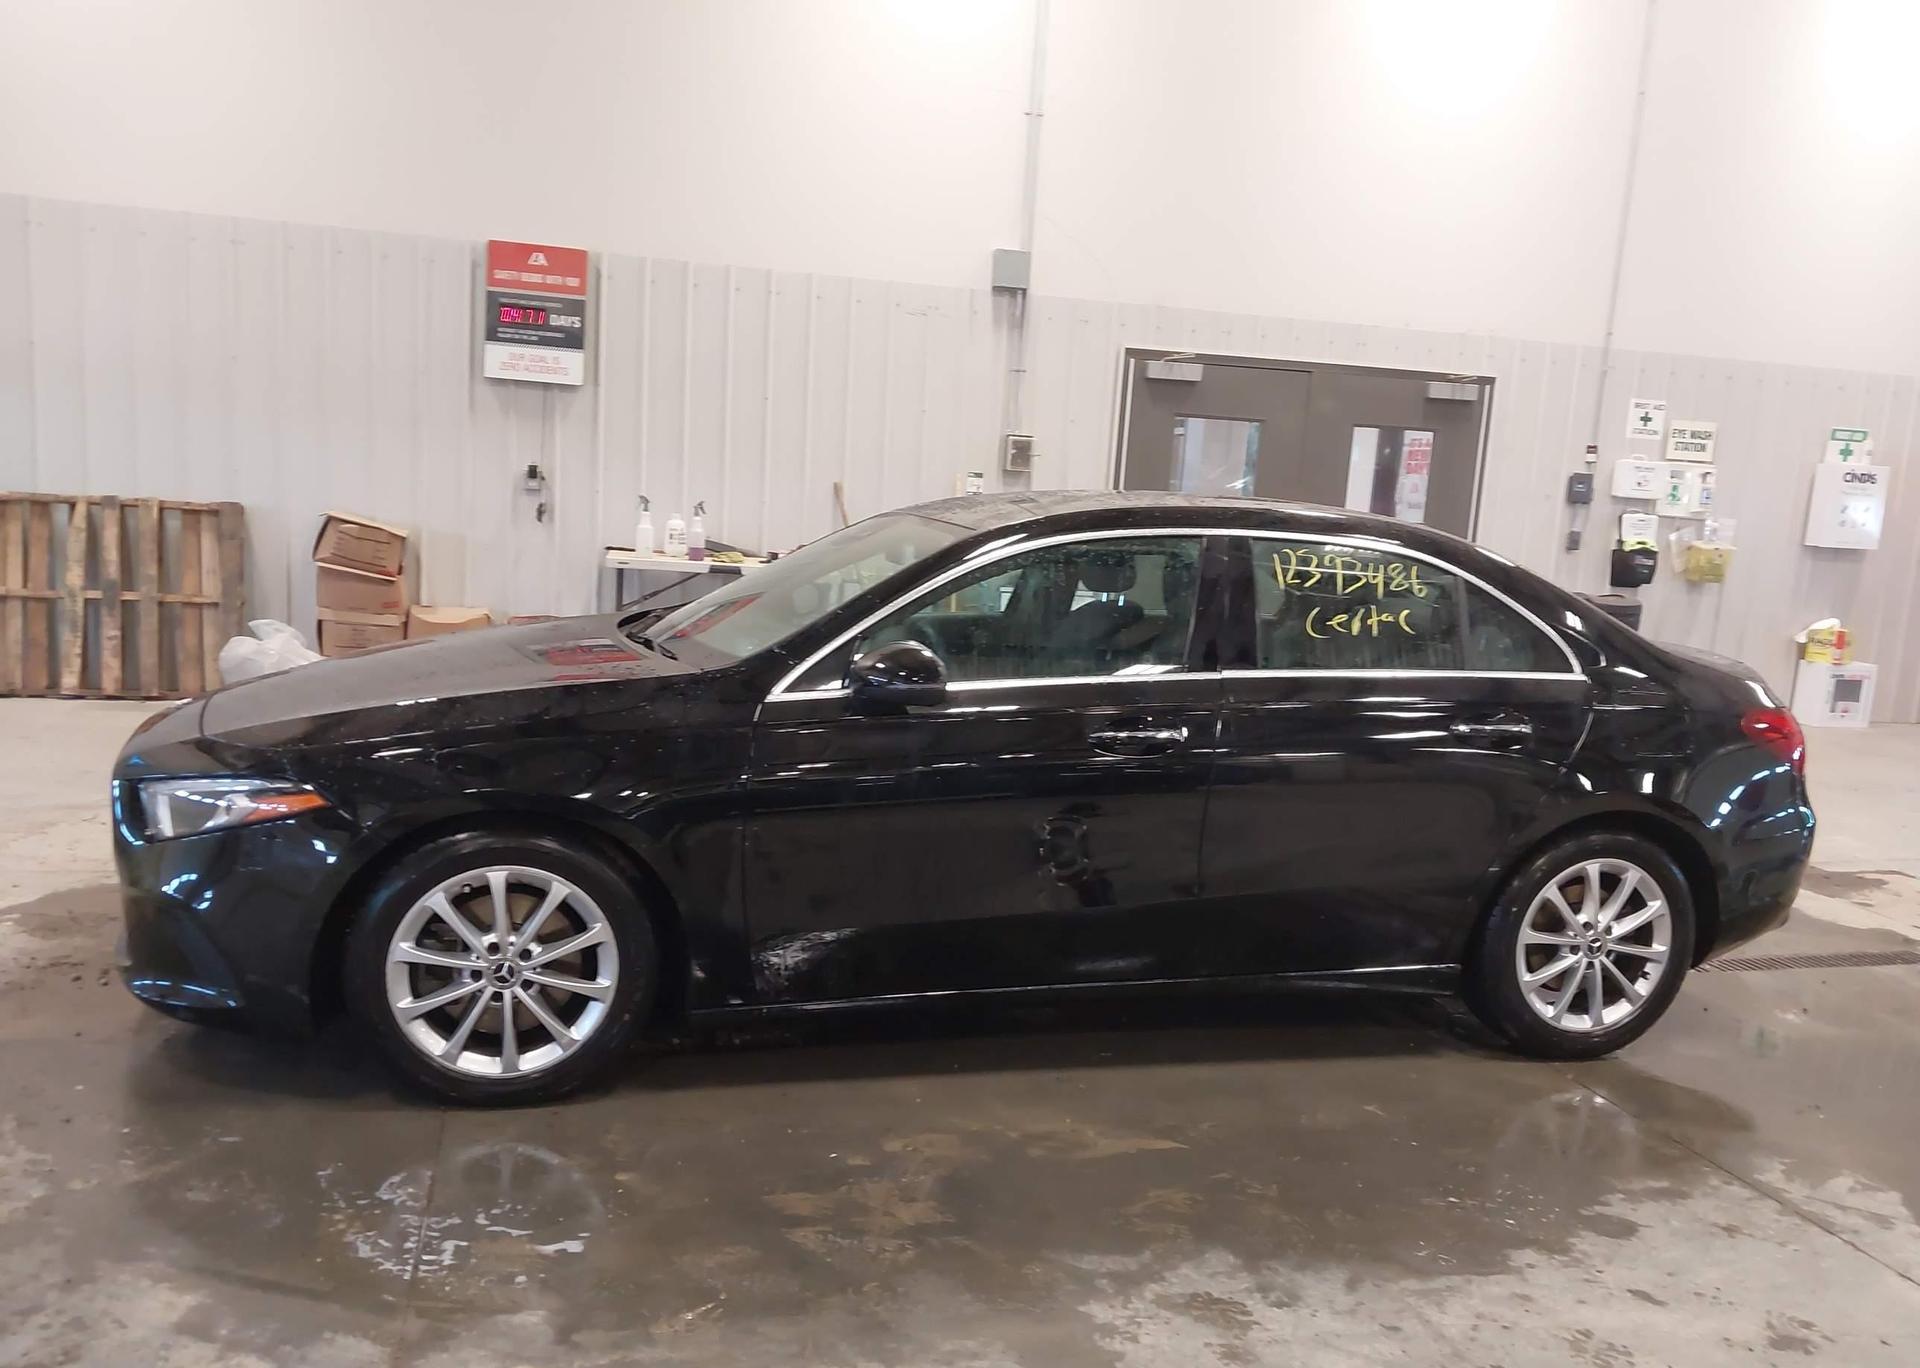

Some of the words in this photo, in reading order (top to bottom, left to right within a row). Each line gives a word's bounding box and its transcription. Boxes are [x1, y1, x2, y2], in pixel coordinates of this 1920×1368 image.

[549, 314, 582, 328] DAYS
[528, 353, 550, 364] GOAL
[523, 363, 570, 376] ACCIDENTS
[1671, 428, 1688, 439] EYE
[1690, 430, 1713, 441] WASH
[1674, 441, 1707, 453] STATION
